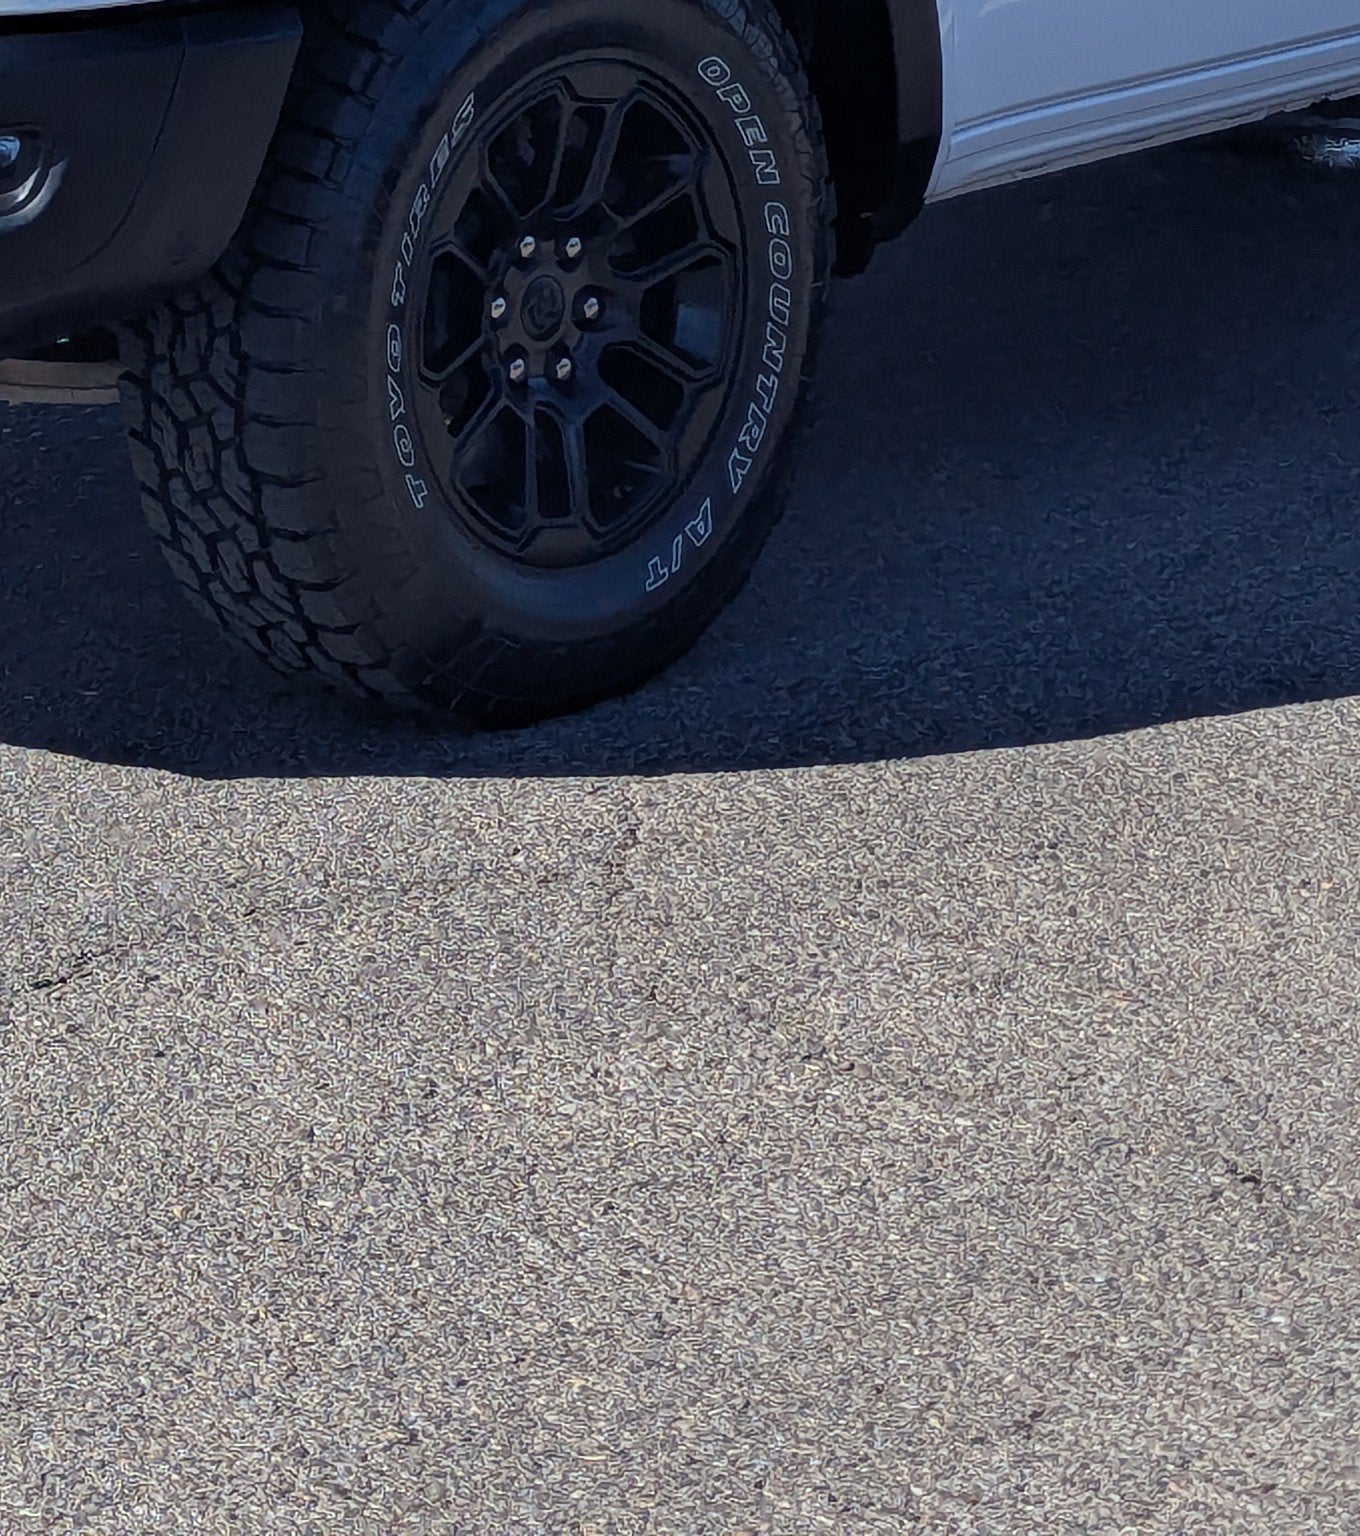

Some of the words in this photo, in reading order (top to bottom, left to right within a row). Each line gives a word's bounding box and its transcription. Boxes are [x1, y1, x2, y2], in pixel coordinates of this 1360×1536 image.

[391, 92, 475, 307] TIRES
[698, 55, 780, 186] OPEN
[387, 324, 429, 509] TOYO
[727, 200, 792, 495] COUNTRY
[645, 497, 713, 592] A/T
